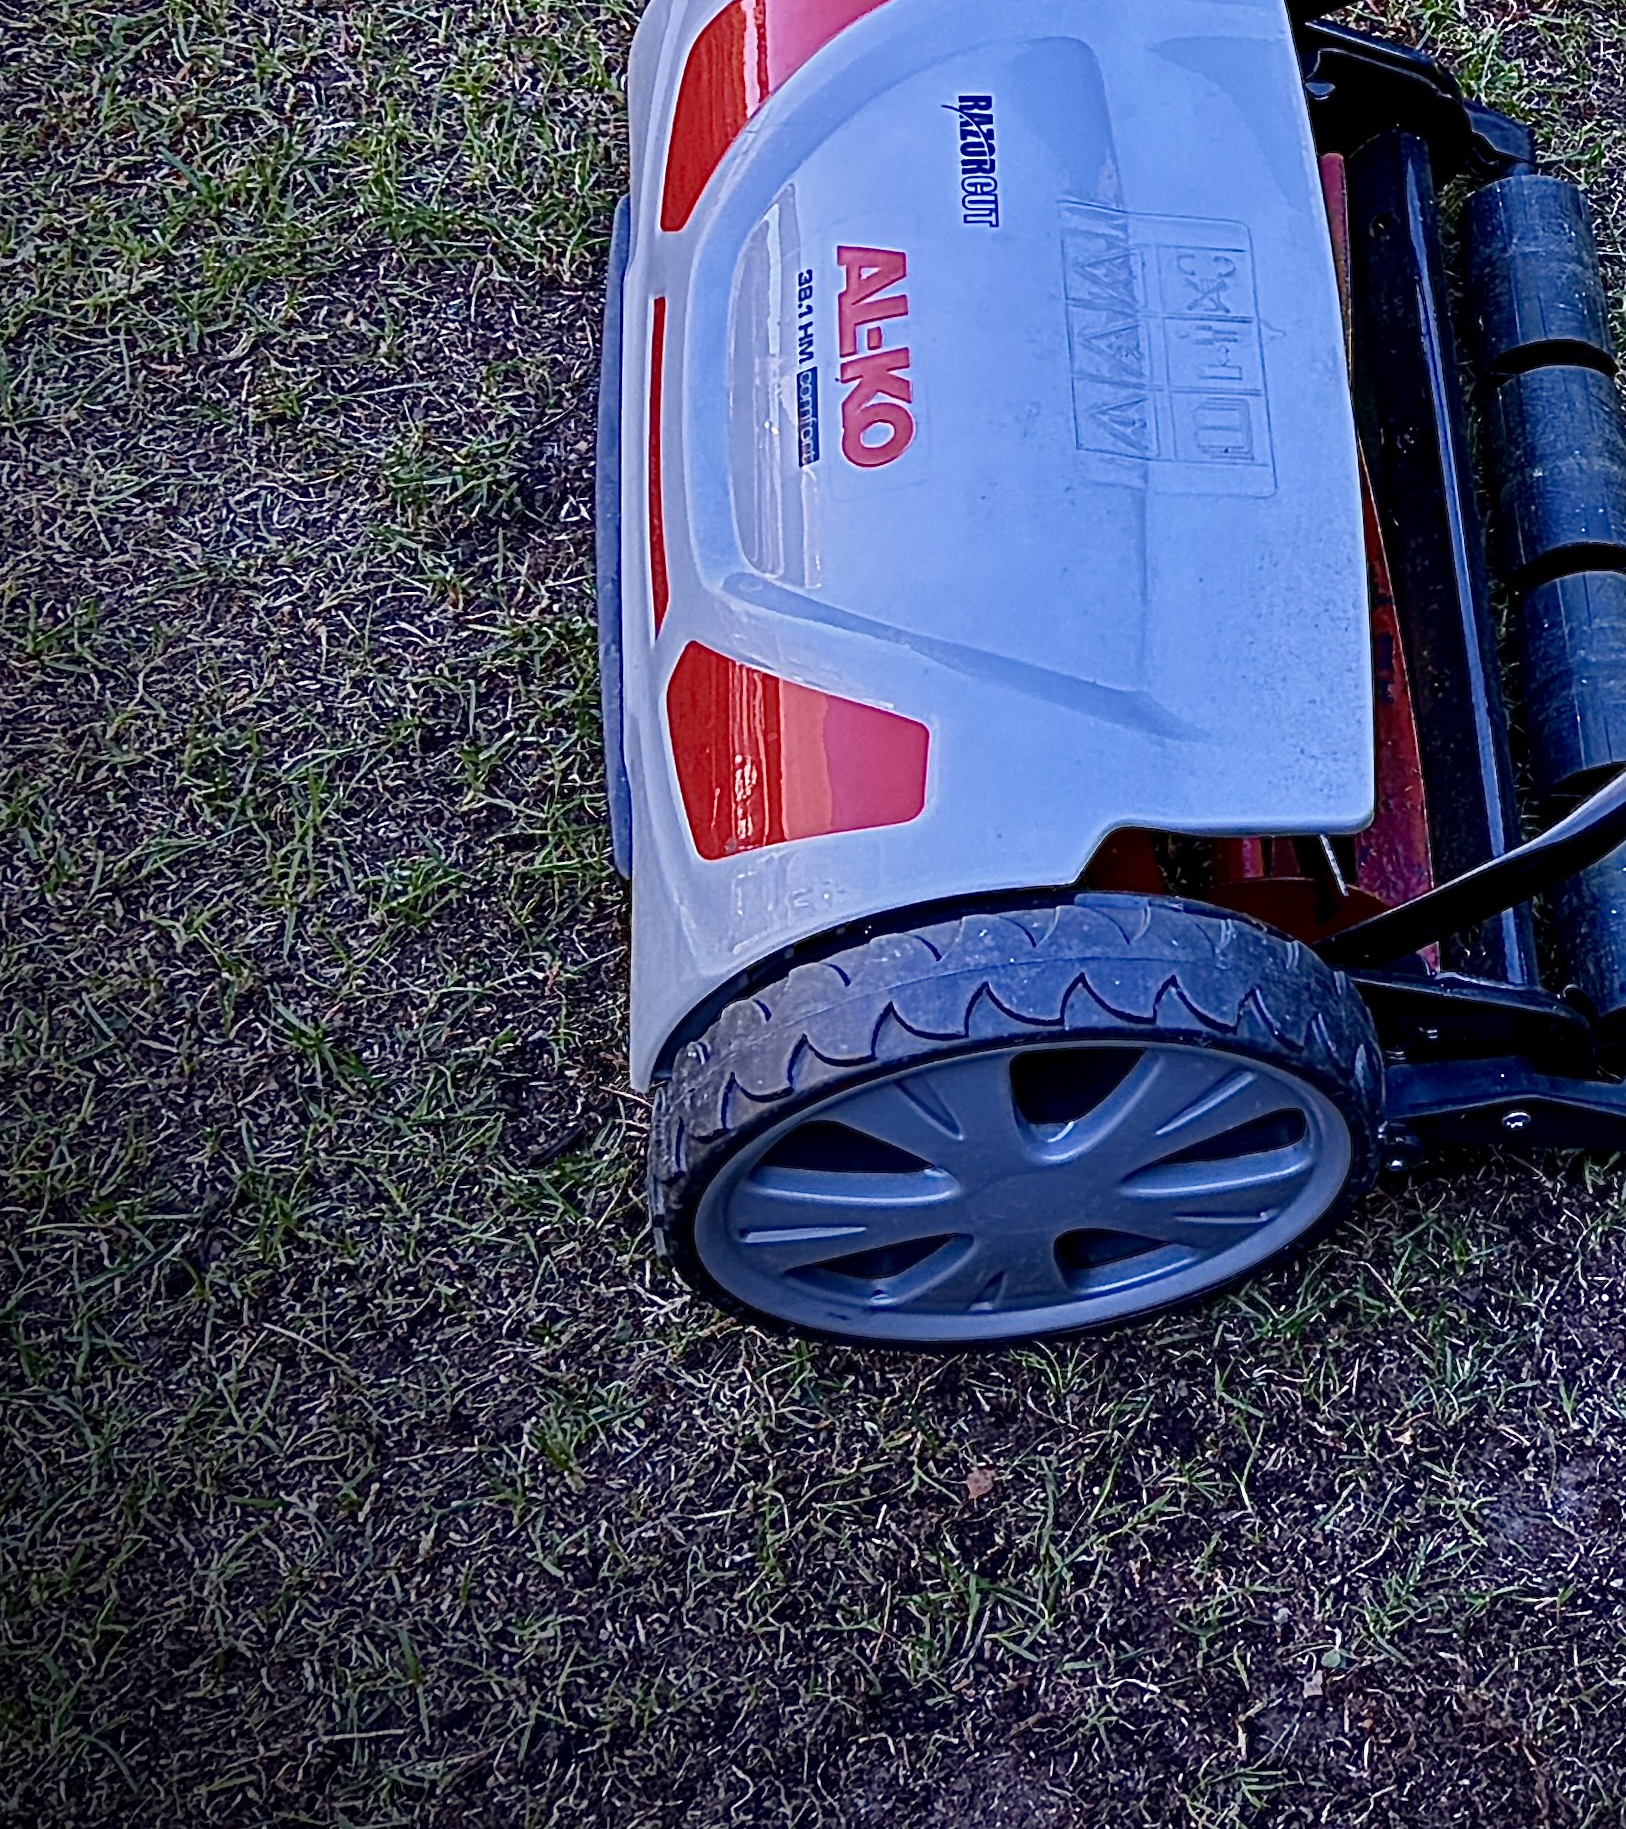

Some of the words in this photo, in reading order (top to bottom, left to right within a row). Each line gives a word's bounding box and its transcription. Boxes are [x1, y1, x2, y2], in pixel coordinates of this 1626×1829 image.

[953, 95, 999, 227] RAZORCUT
[798, 269, 813, 319] 38.1
[798, 323, 814, 364] HM
[838, 246, 914, 468] AL-KO
[799, 369, 818, 466] comfort
